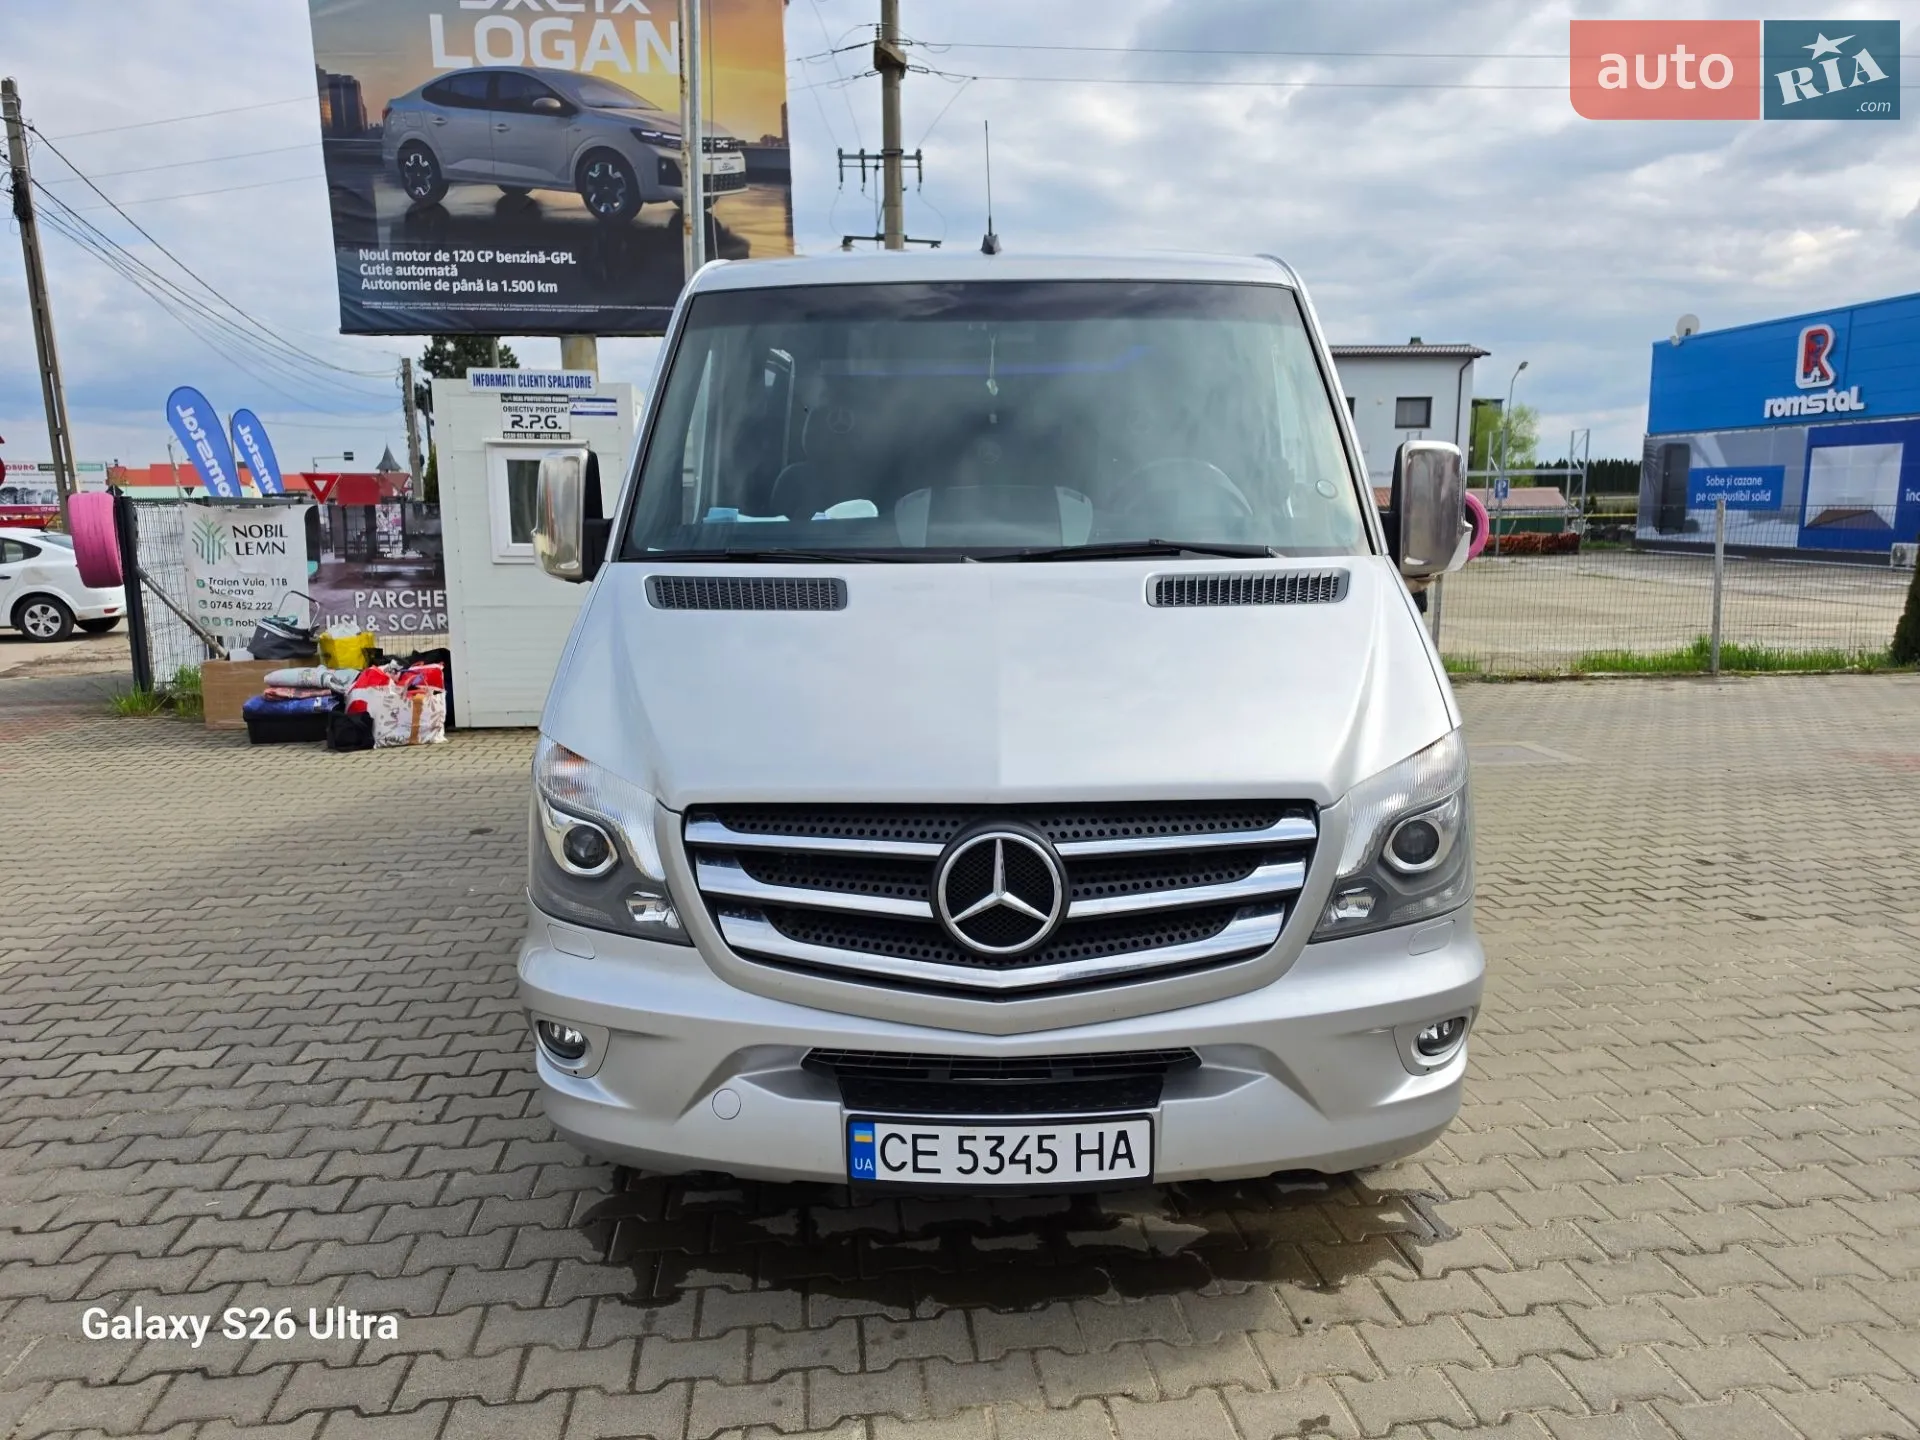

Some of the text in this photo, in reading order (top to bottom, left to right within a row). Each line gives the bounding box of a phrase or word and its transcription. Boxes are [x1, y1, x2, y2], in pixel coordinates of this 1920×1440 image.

[429, 13, 679, 75] LOGAN
[359, 249, 576, 264] Noul motor de 120 CP benzină-GPL
[360, 263, 458, 277] Cutie automată
[361, 278, 557, 294] Autonomie de până la 1.500 km
[472, 373, 592, 389] INFORMATII CLIENTI SPALATORIE
[502, 405, 533, 413] OBIECTIV
[510, 414, 562, 430] R.P.G.
[1706, 475, 1725, 486] Sobe
[1734, 476, 1763, 486] cazane
[1696, 490, 1771, 503] pe combustibil solid
[232, 524, 288, 539] NOBIL
[235, 541, 286, 556] LEMN
[208, 577, 288, 588] Traian Vuia, 11B
[209, 586, 254, 596] Suceava
[210, 601, 273, 610] 0745 452 222
[366, 615, 381, 632] &
[879, 1129, 1136, 1176] CE 5345 HA
[854, 1157, 874, 1171] UA
